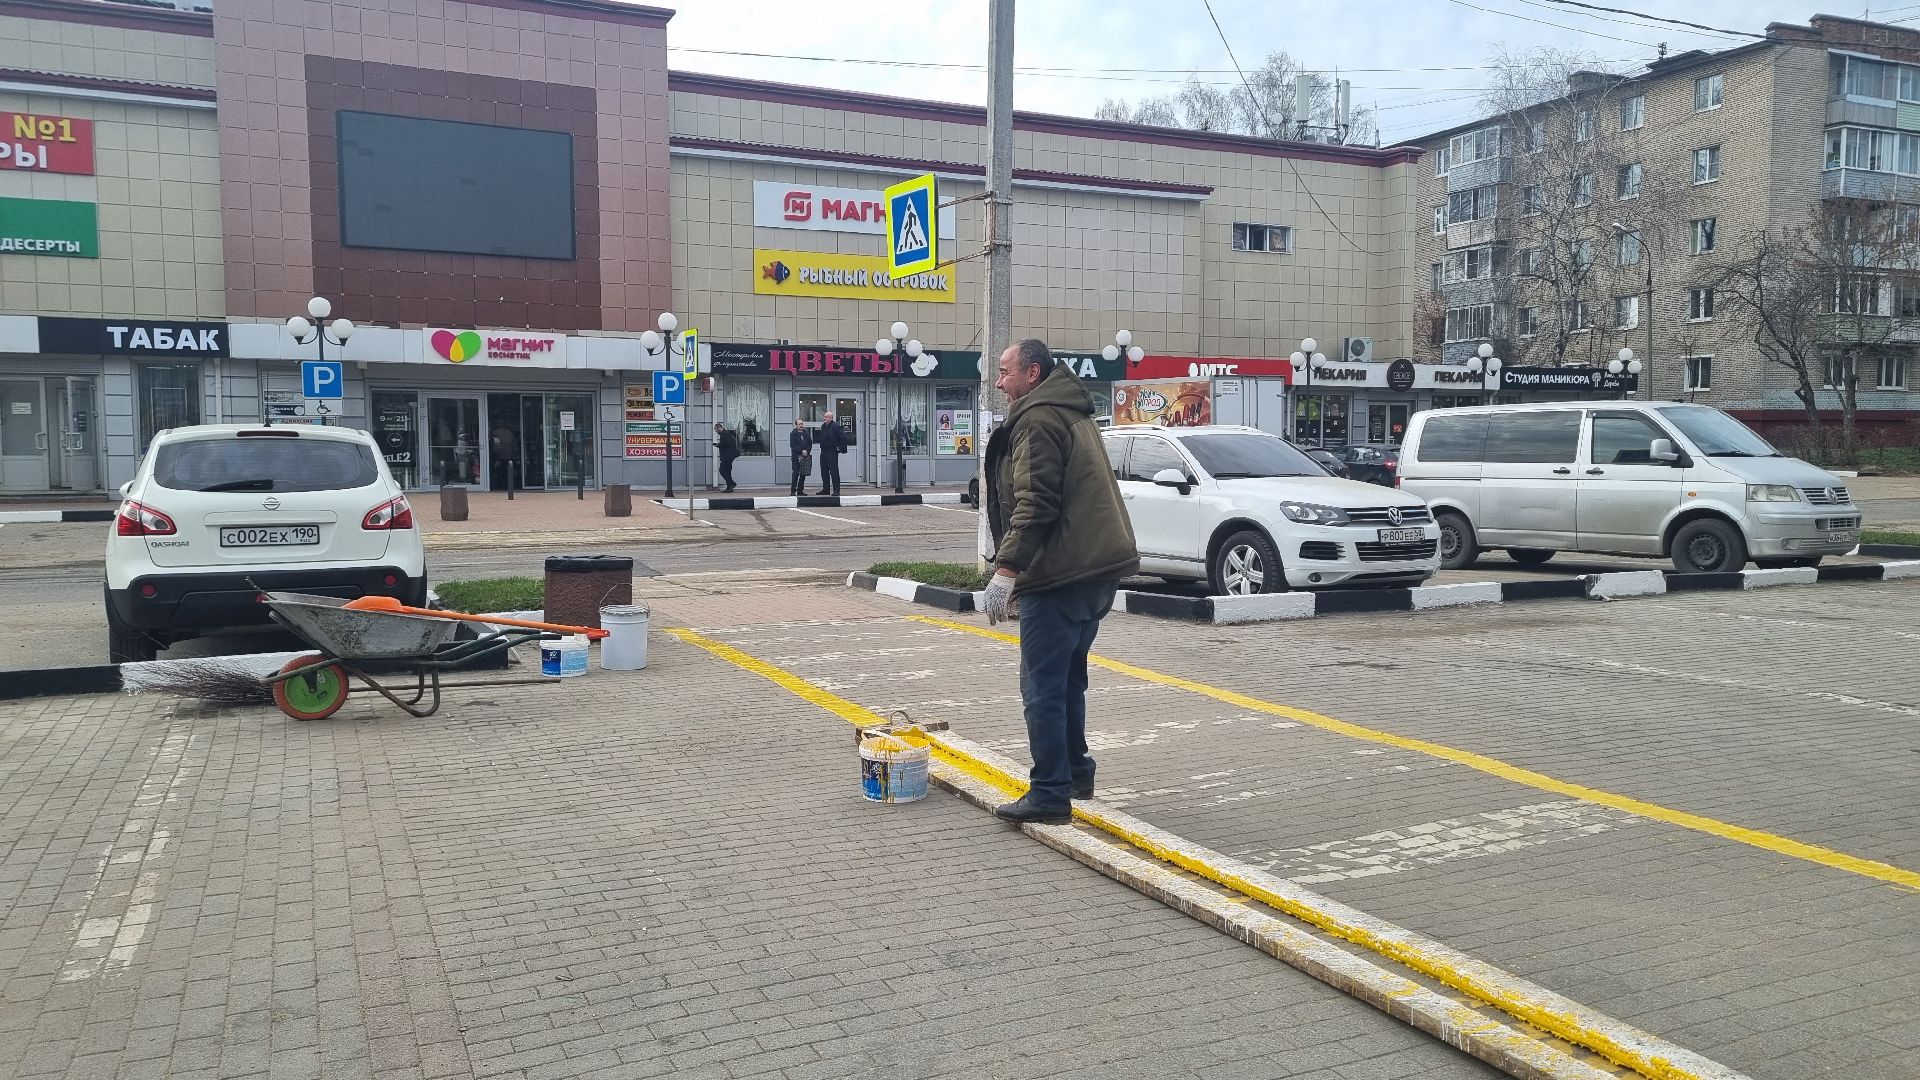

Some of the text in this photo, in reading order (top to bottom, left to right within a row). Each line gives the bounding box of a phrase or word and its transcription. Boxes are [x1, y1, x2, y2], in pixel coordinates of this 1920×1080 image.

[13, 114, 77, 142] №1
[822, 199, 886, 222] МАГН
[0, 237, 81, 253] ДЕСЕРТЫ
[799, 267, 868, 287] РЫБНЫЙ
[106, 326, 220, 351] ТАБАК
[768, 349, 905, 377] ЦВЕТЫ
[1200, 363, 1239, 376] МТС
[313, 366, 335, 394] P
[1314, 367, 1368, 381] ПЕКАРНЯ
[661, 375, 680, 401] P
[629, 448, 680, 456] ХОЗТОВАЫ
[292, 527, 315, 539] 190
